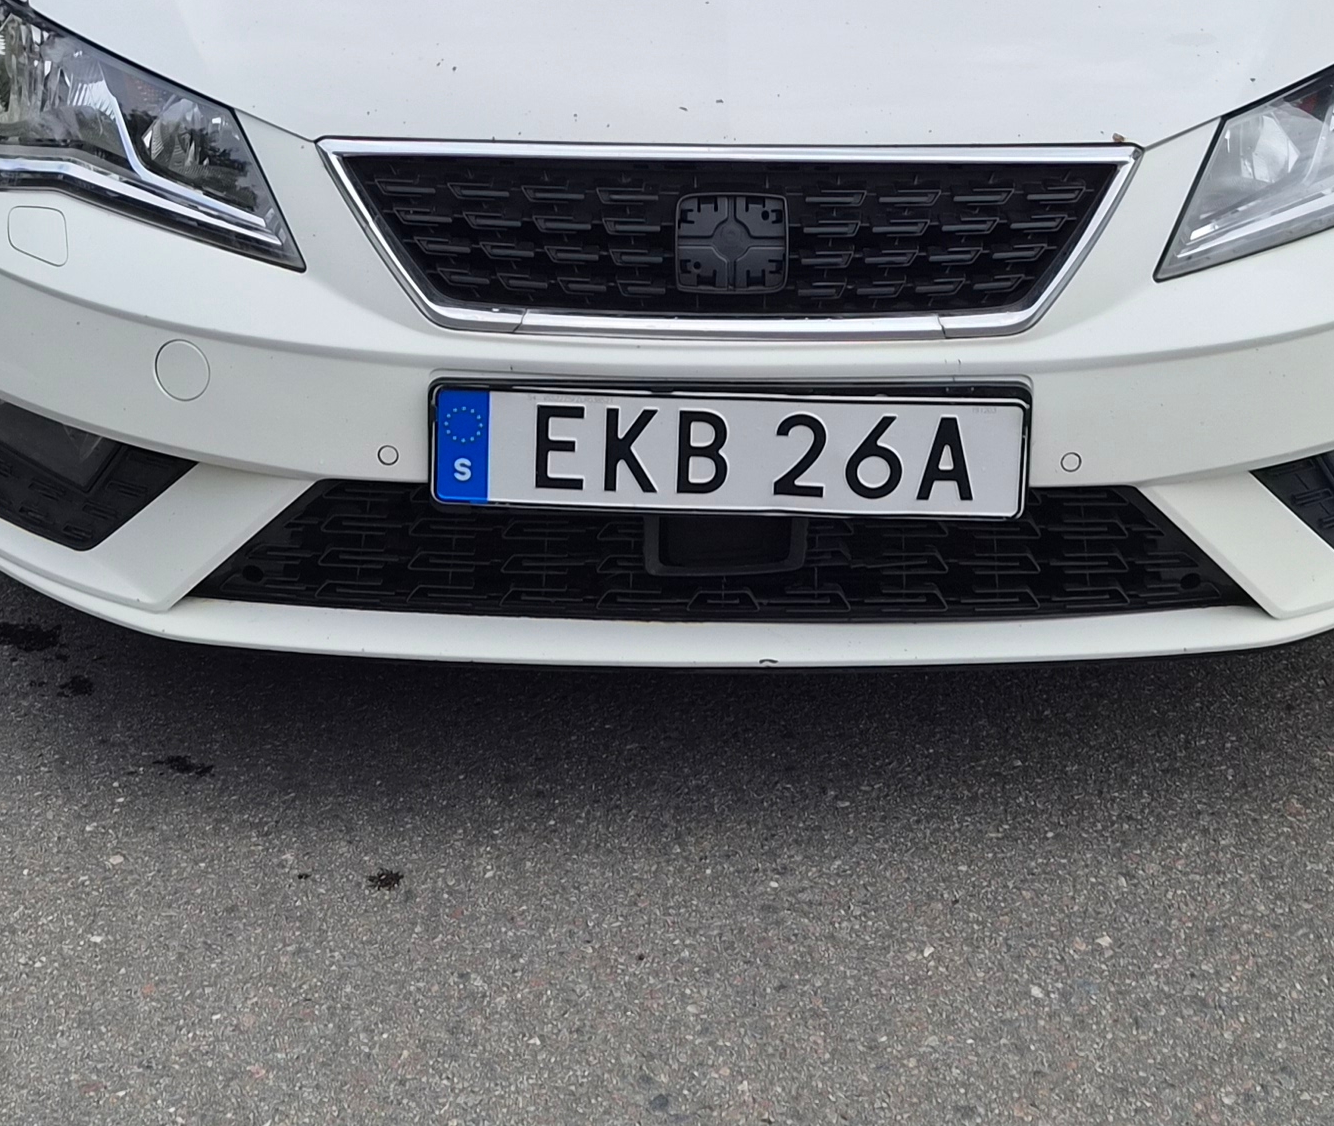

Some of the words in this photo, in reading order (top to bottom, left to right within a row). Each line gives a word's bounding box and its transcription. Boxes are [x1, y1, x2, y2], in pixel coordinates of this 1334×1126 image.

[453, 458, 472, 482] S
[534, 404, 728, 495] EKB
[772, 413, 974, 501] 26A
